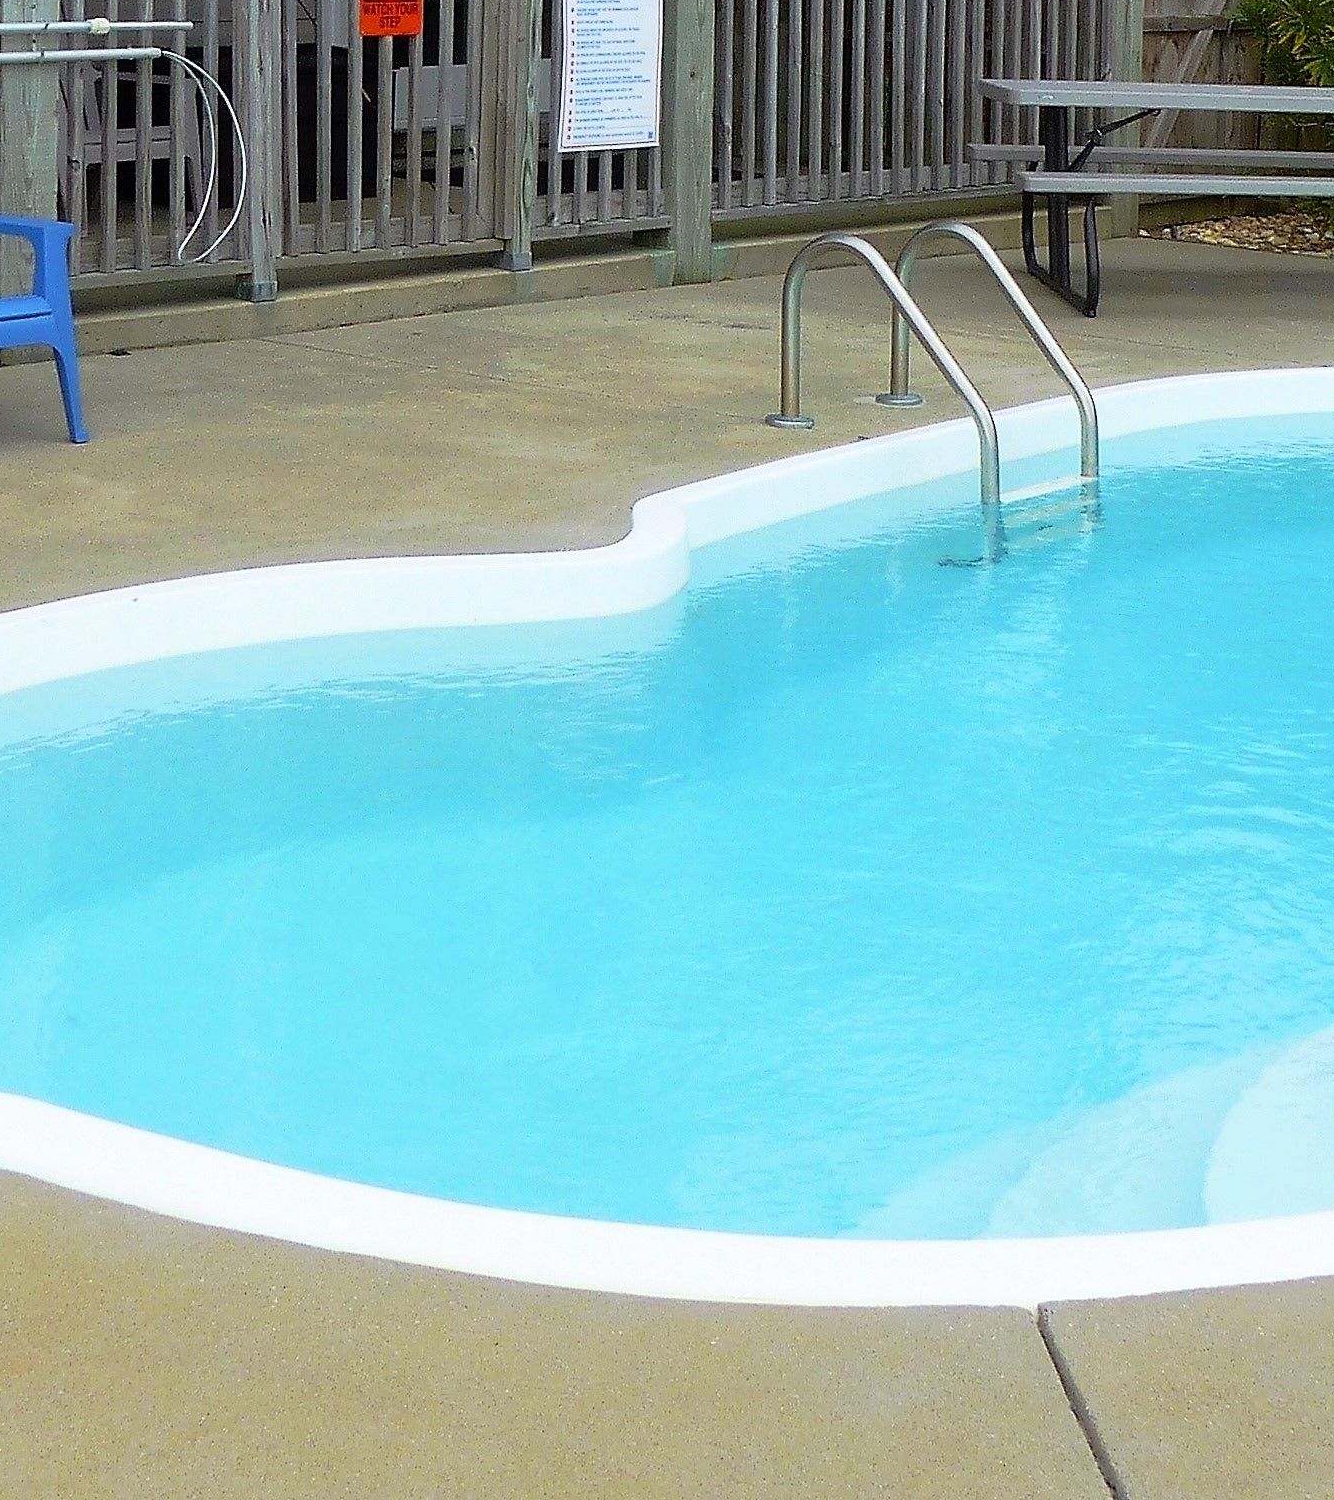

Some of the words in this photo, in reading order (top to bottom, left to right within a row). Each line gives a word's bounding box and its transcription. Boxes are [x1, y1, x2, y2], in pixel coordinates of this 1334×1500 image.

[364, 3, 393, 15] WATCH
[395, 3, 418, 15] YOUR
[379, 16, 401, 29] STEP
